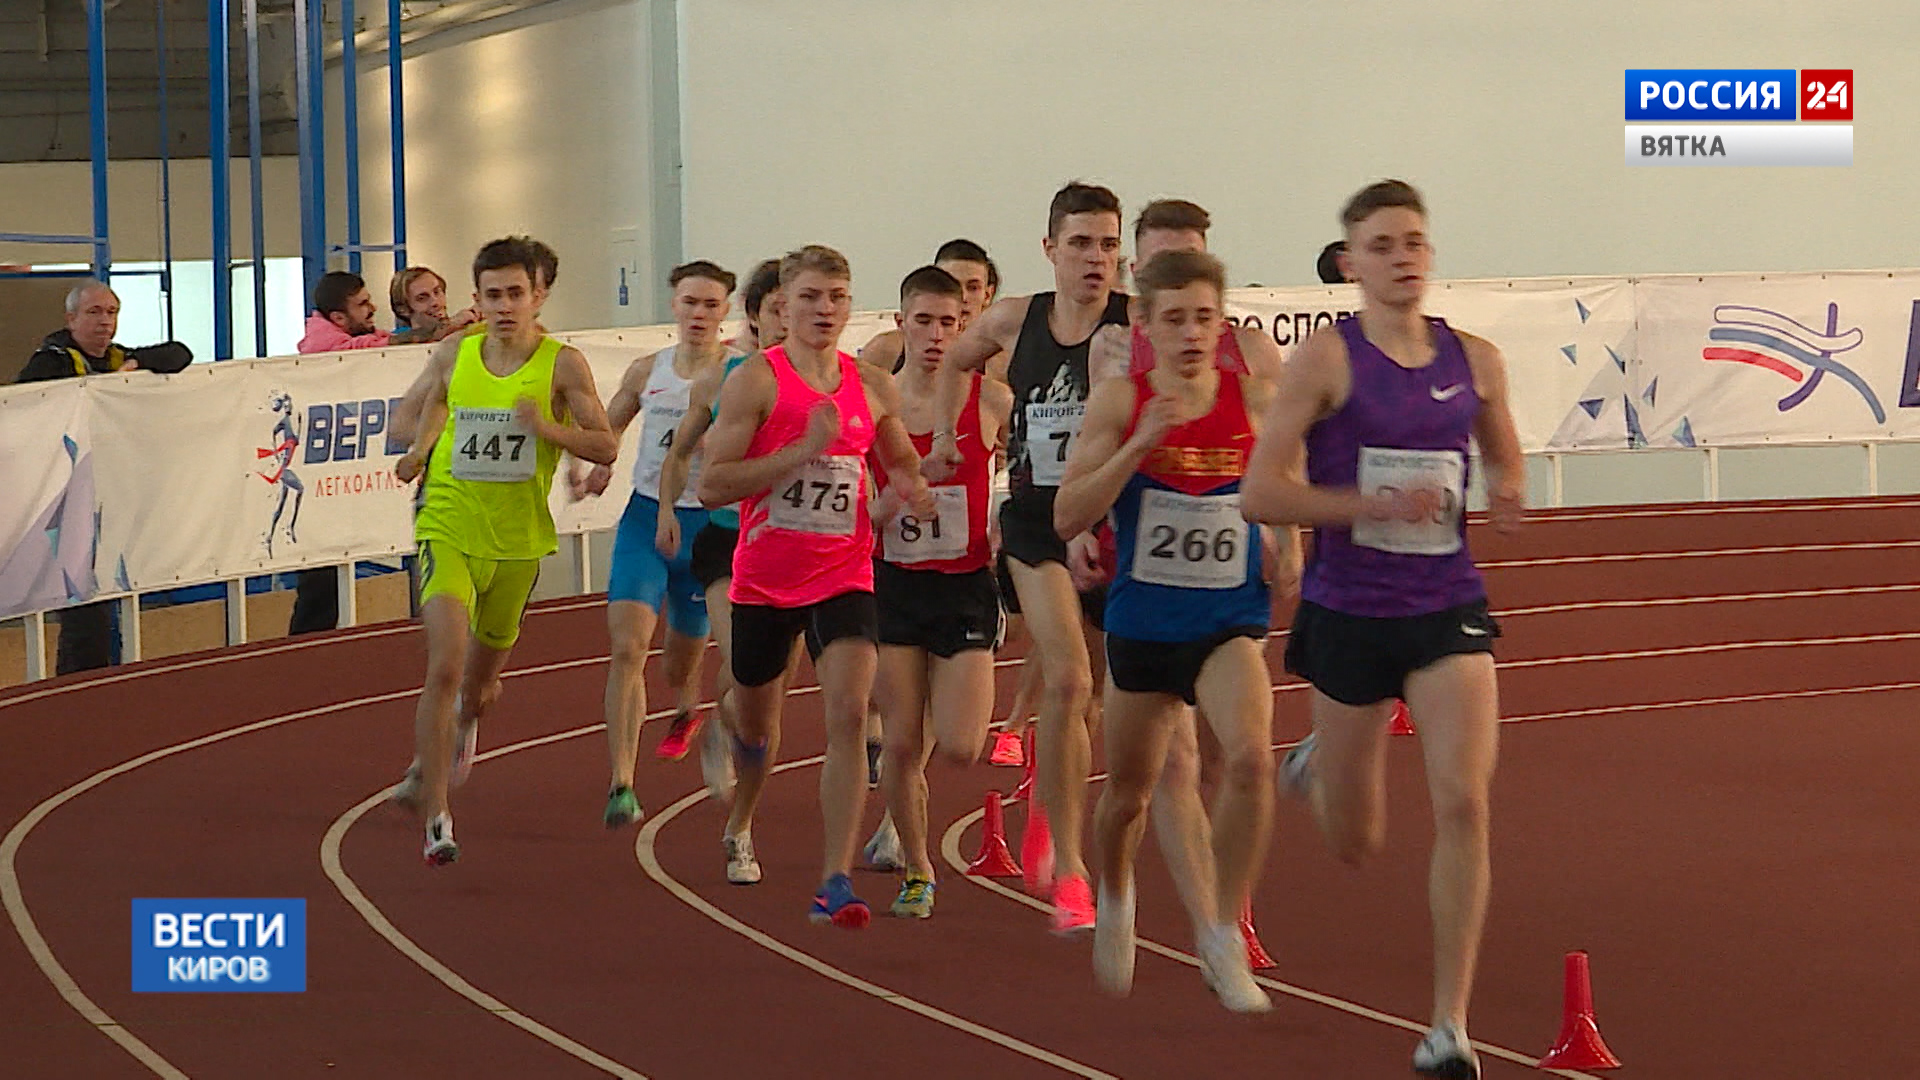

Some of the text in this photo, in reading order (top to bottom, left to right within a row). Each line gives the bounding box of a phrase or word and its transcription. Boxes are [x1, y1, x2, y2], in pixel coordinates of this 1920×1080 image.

[460, 433, 526, 461] 447
[782, 478, 850, 512] 475
[1150, 524, 1237, 563] 266
